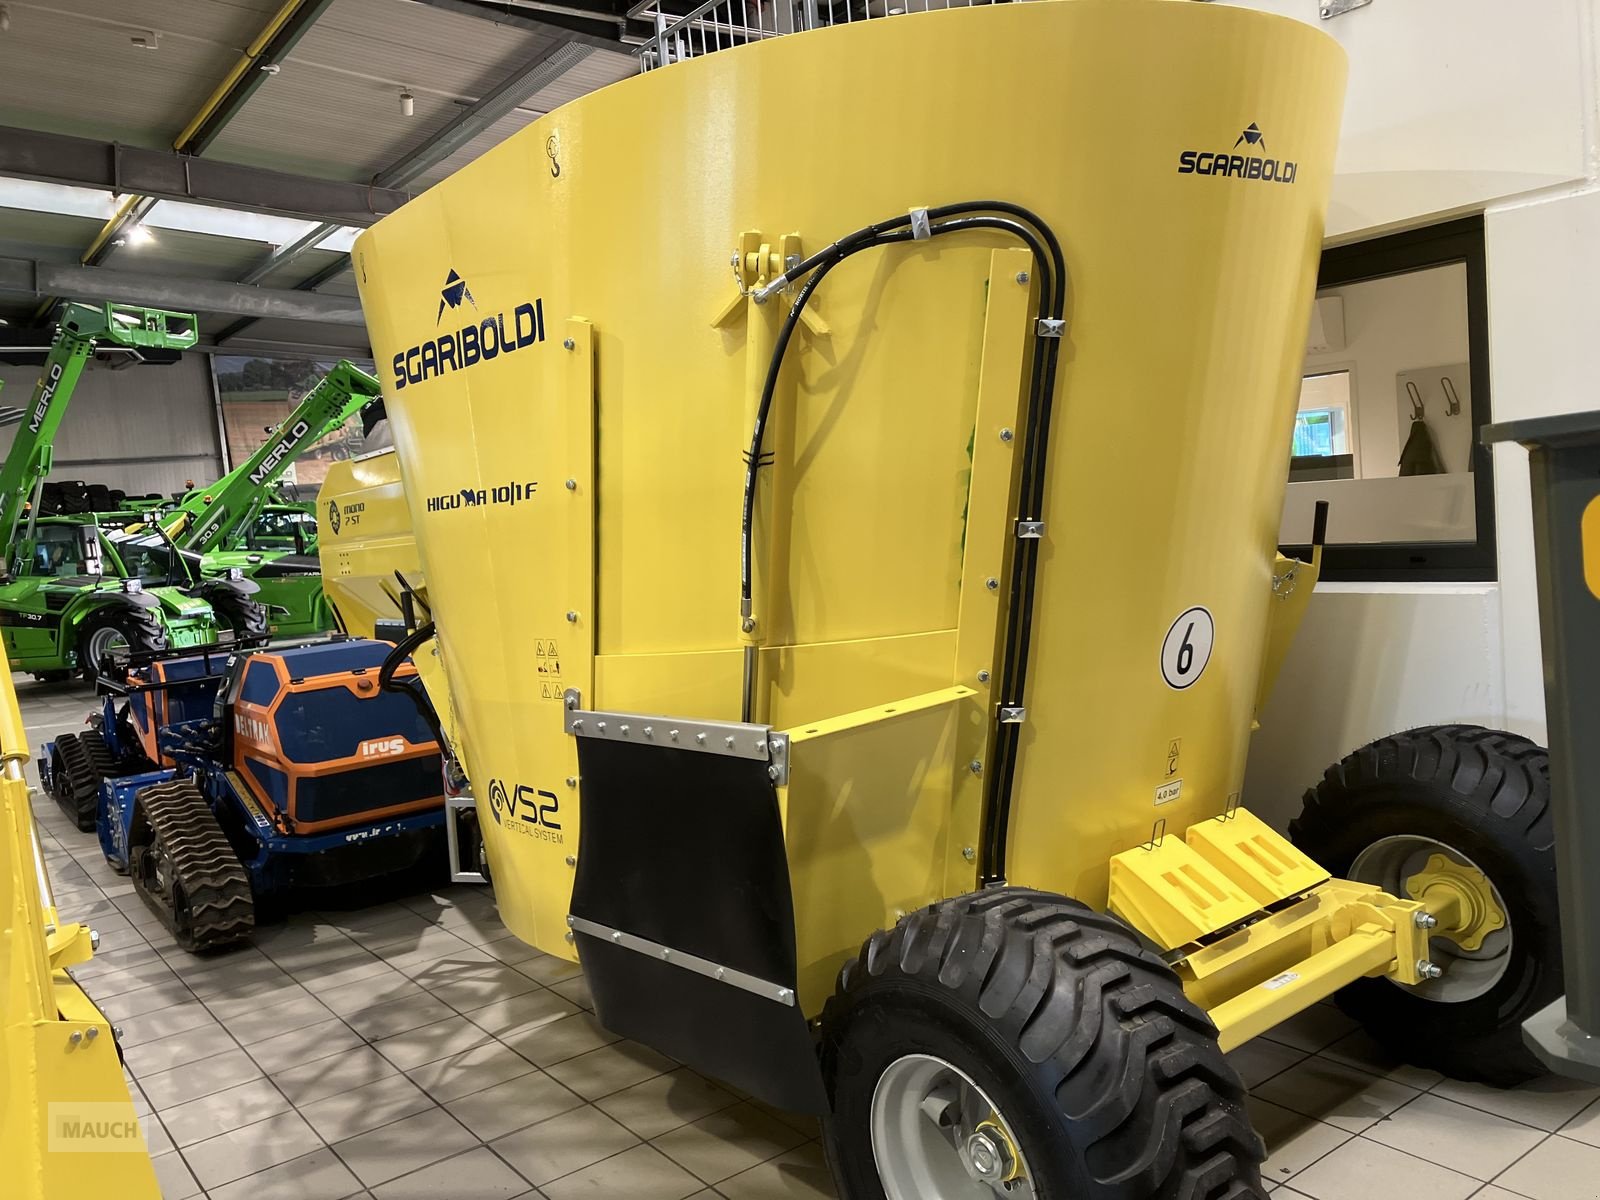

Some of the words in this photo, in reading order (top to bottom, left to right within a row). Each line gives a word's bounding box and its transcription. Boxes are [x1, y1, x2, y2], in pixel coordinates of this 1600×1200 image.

[1178, 151, 1298, 184] SGARIBOLDI
[393, 298, 545, 390] SGARIBOLDI
[29, 364, 62, 433] MERLO
[250, 421, 309, 485] MERLO
[525, 482, 538, 500] F
[199, 523, 220, 545] 30.9
[1177, 622, 1194, 675] 6
[362, 738, 405, 756] irus
[1168, 787, 1180, 797] bar
[503, 818, 534, 838] VERTICAL
[534, 827, 564, 845] SYSTEM
